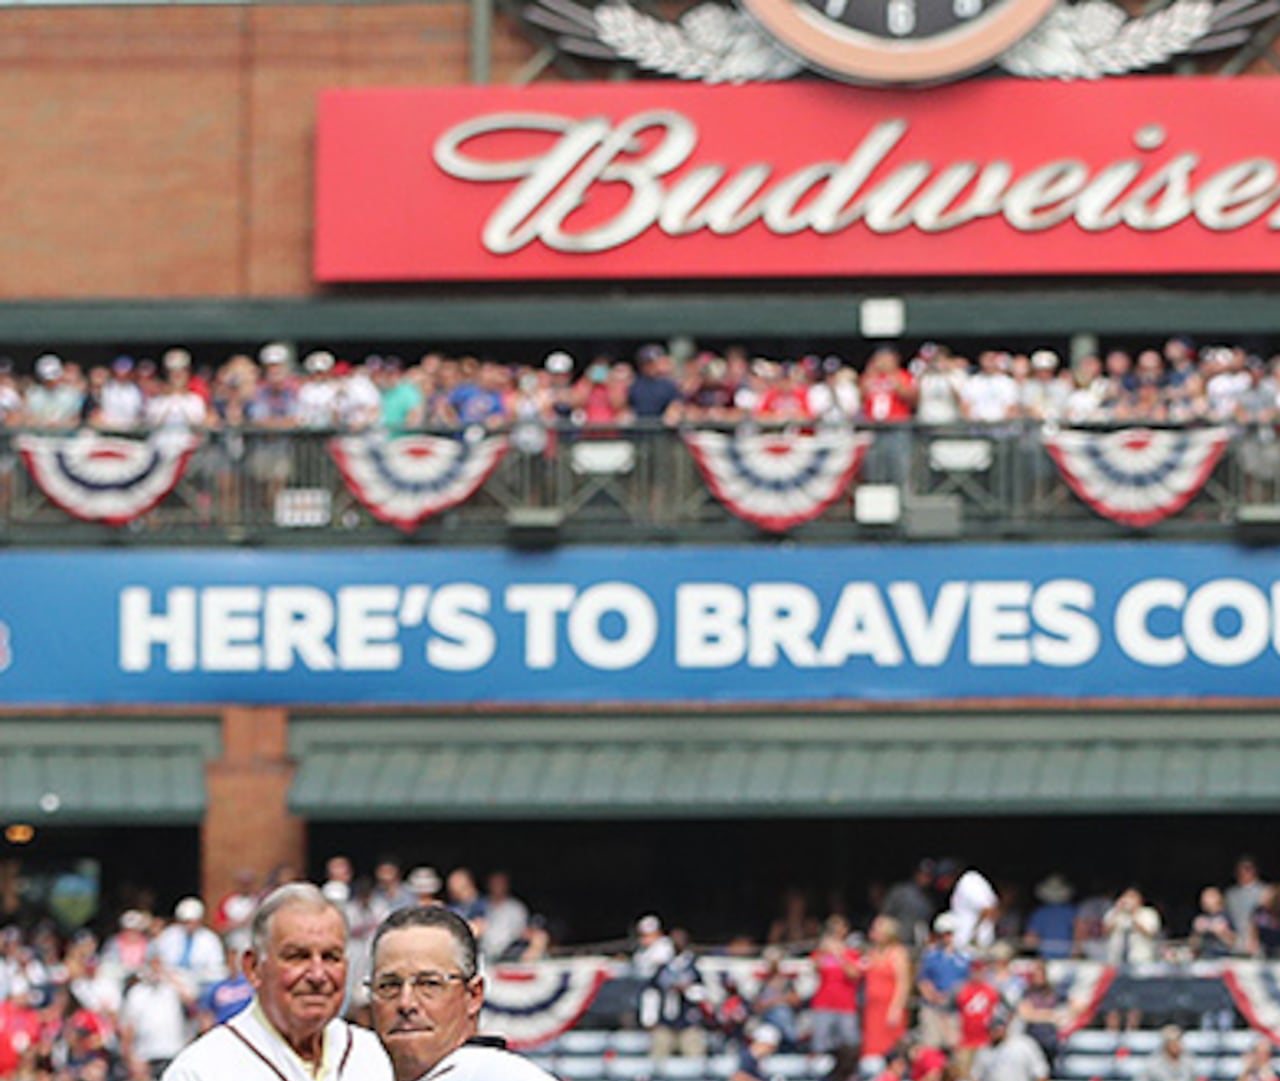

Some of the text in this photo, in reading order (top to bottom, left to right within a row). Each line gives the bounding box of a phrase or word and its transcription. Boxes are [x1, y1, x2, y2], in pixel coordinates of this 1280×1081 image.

[119, 582, 498, 672] HERE'S
[504, 581, 659, 670] TO
[674, 578, 1101, 668] BRAVES
